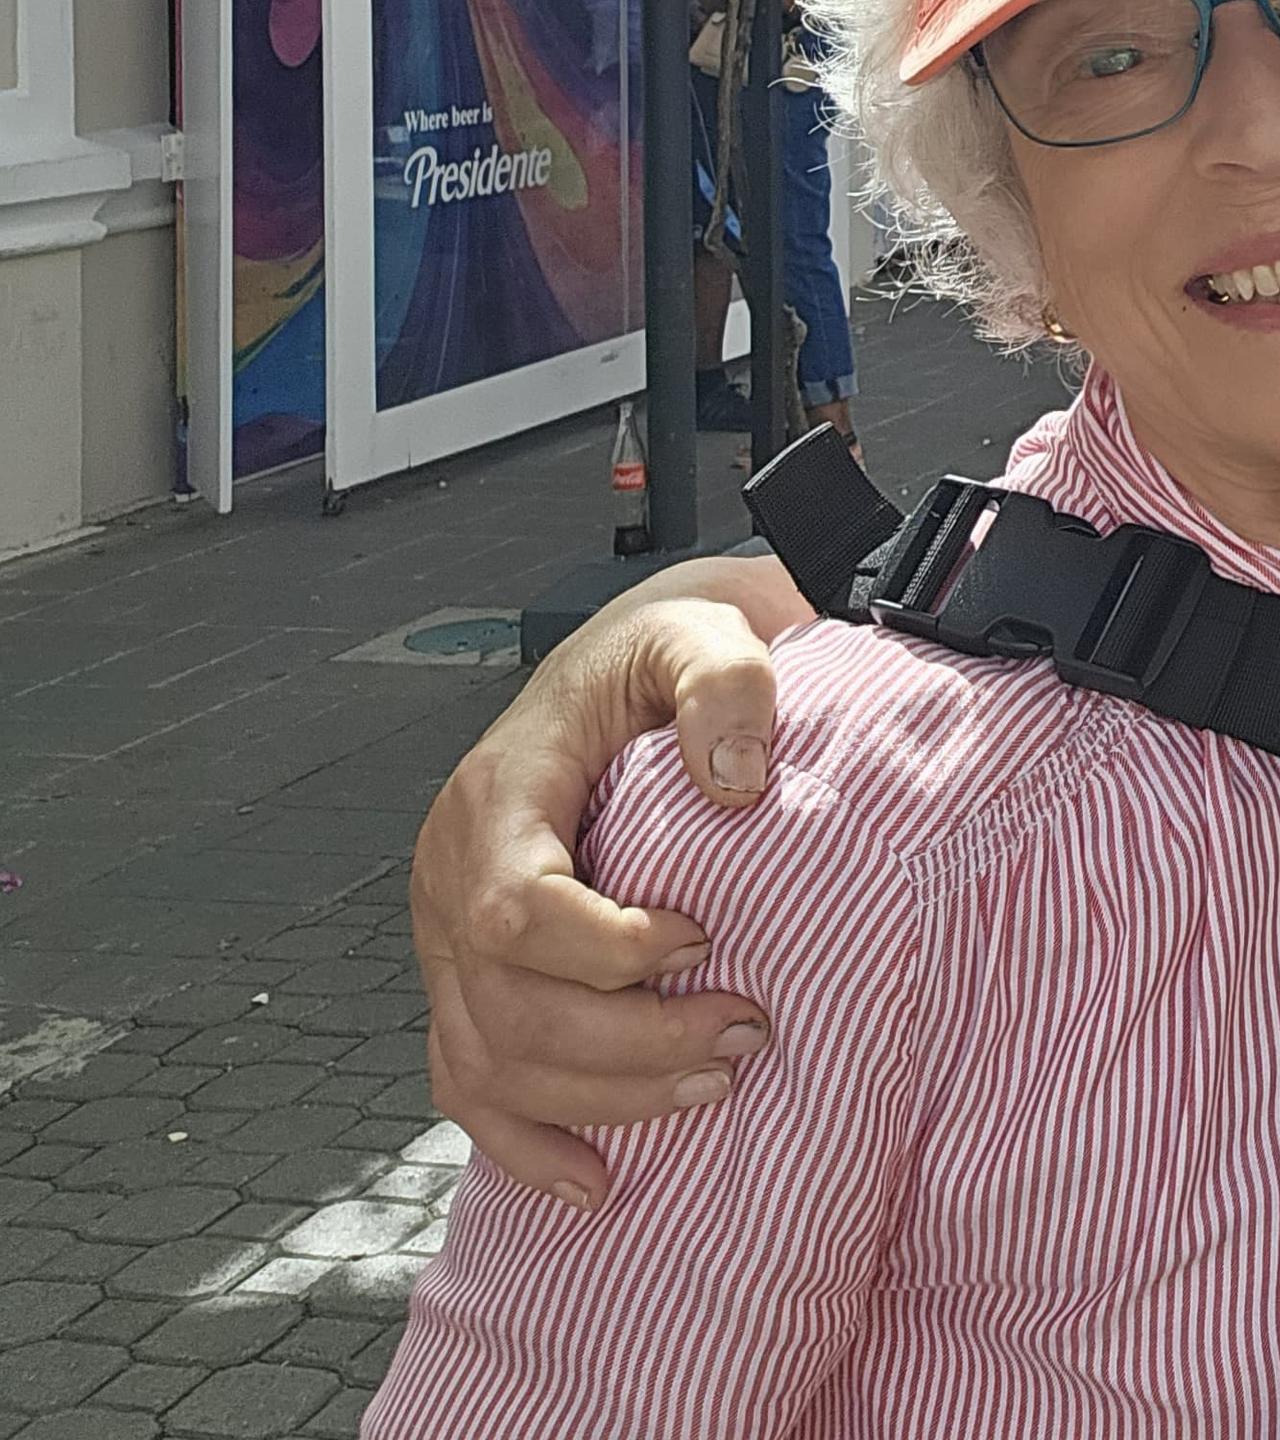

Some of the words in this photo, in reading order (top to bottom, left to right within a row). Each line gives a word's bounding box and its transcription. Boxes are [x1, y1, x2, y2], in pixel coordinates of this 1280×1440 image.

[404, 109, 448, 133] Where
[451, 105, 480, 128] beer
[482, 101, 493, 124] is
[404, 144, 551, 208] Presidente
